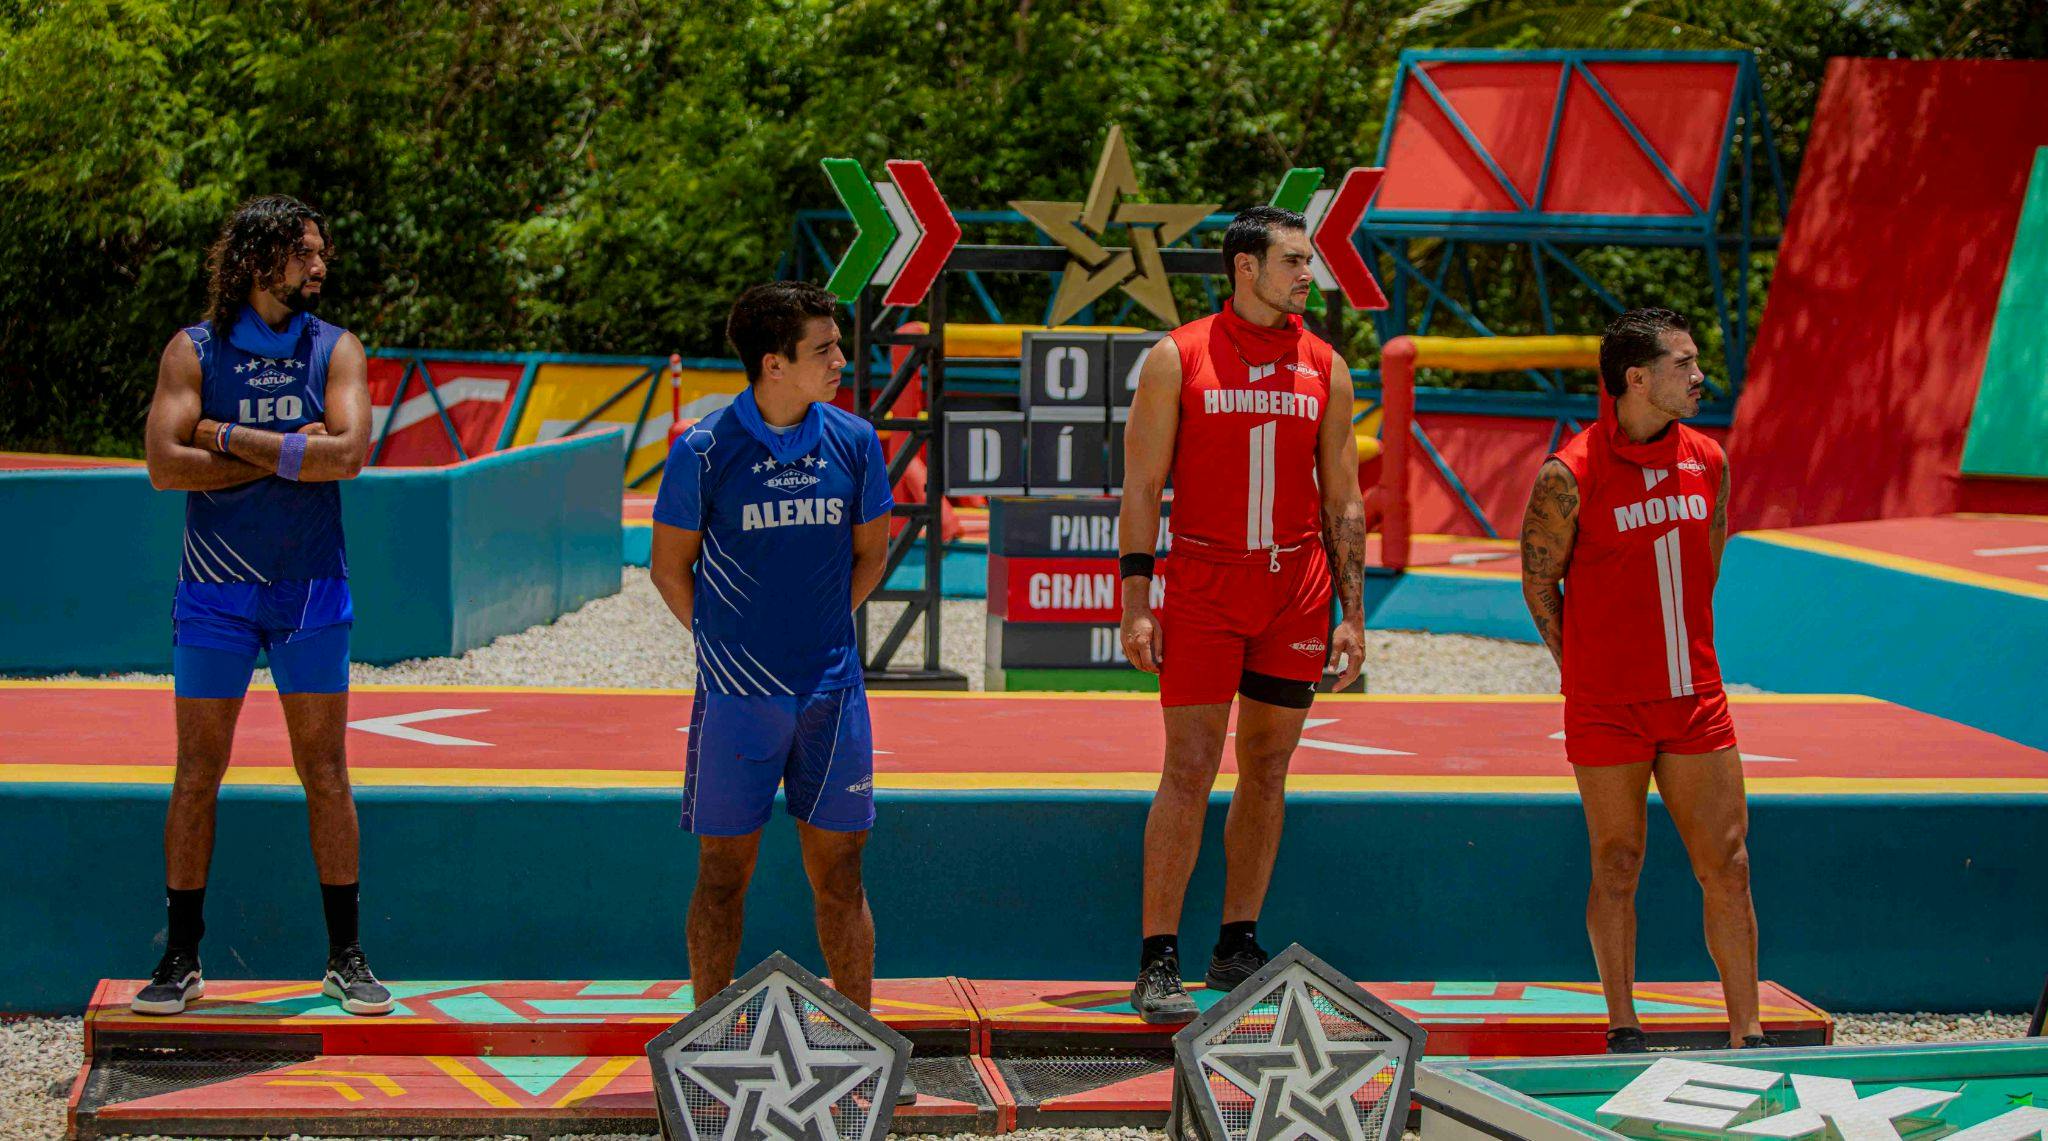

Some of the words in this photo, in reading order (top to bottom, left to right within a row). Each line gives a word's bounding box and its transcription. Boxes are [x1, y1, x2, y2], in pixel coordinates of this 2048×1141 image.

[239, 395, 303, 423] LEO
[1204, 389, 1319, 421] HUMBERTO
[968, 426, 1073, 481] DÍ
[742, 498, 844, 531] ALEXIS
[1614, 494, 1707, 532] MONO
[1029, 572, 1114, 610] GRAN
